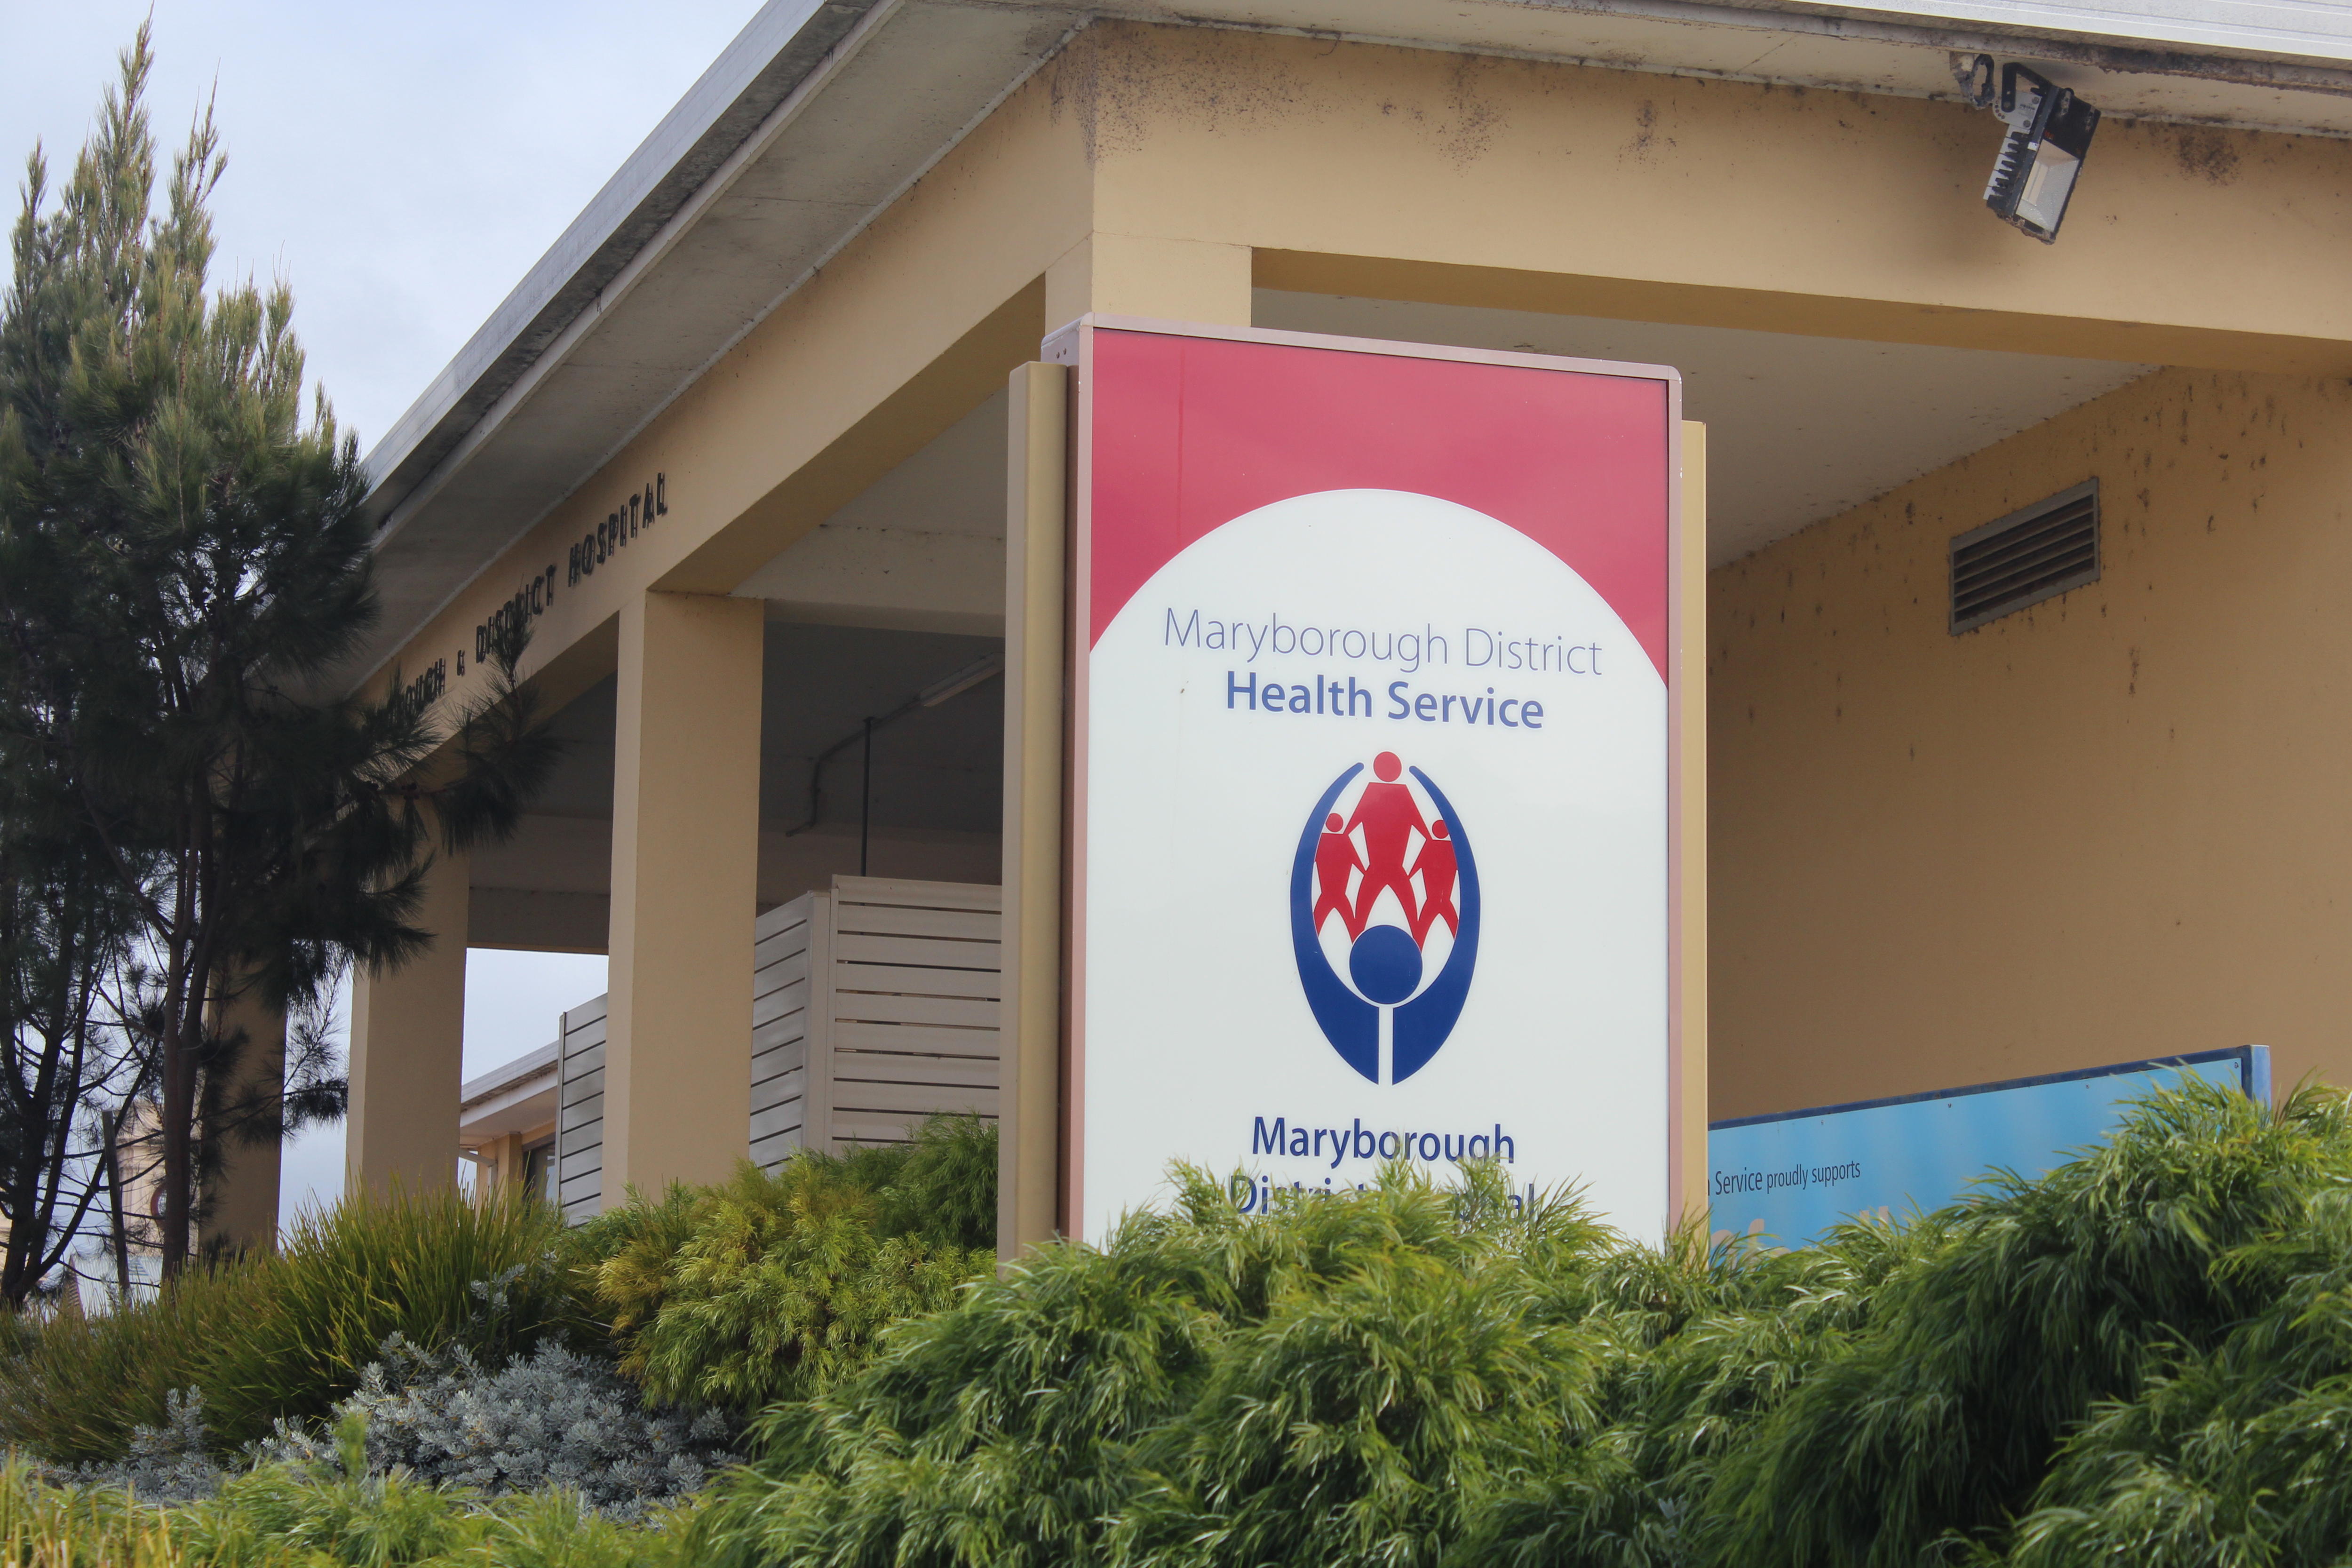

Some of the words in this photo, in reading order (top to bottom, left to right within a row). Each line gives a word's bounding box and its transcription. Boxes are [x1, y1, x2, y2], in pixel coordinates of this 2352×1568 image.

[568, 472, 667, 588] HOSPITAL
[1165, 607, 1448, 673] Maryborough
[1466, 628, 1602, 675] District
[1228, 670, 1372, 717] Health
[1388, 681, 1544, 729] Service
[1252, 1116, 1514, 1169] Maryborough
[1715, 1167, 1763, 1195] Service
[1767, 1164, 1808, 1194] proudly
[1812, 1160, 1861, 1187] supports
